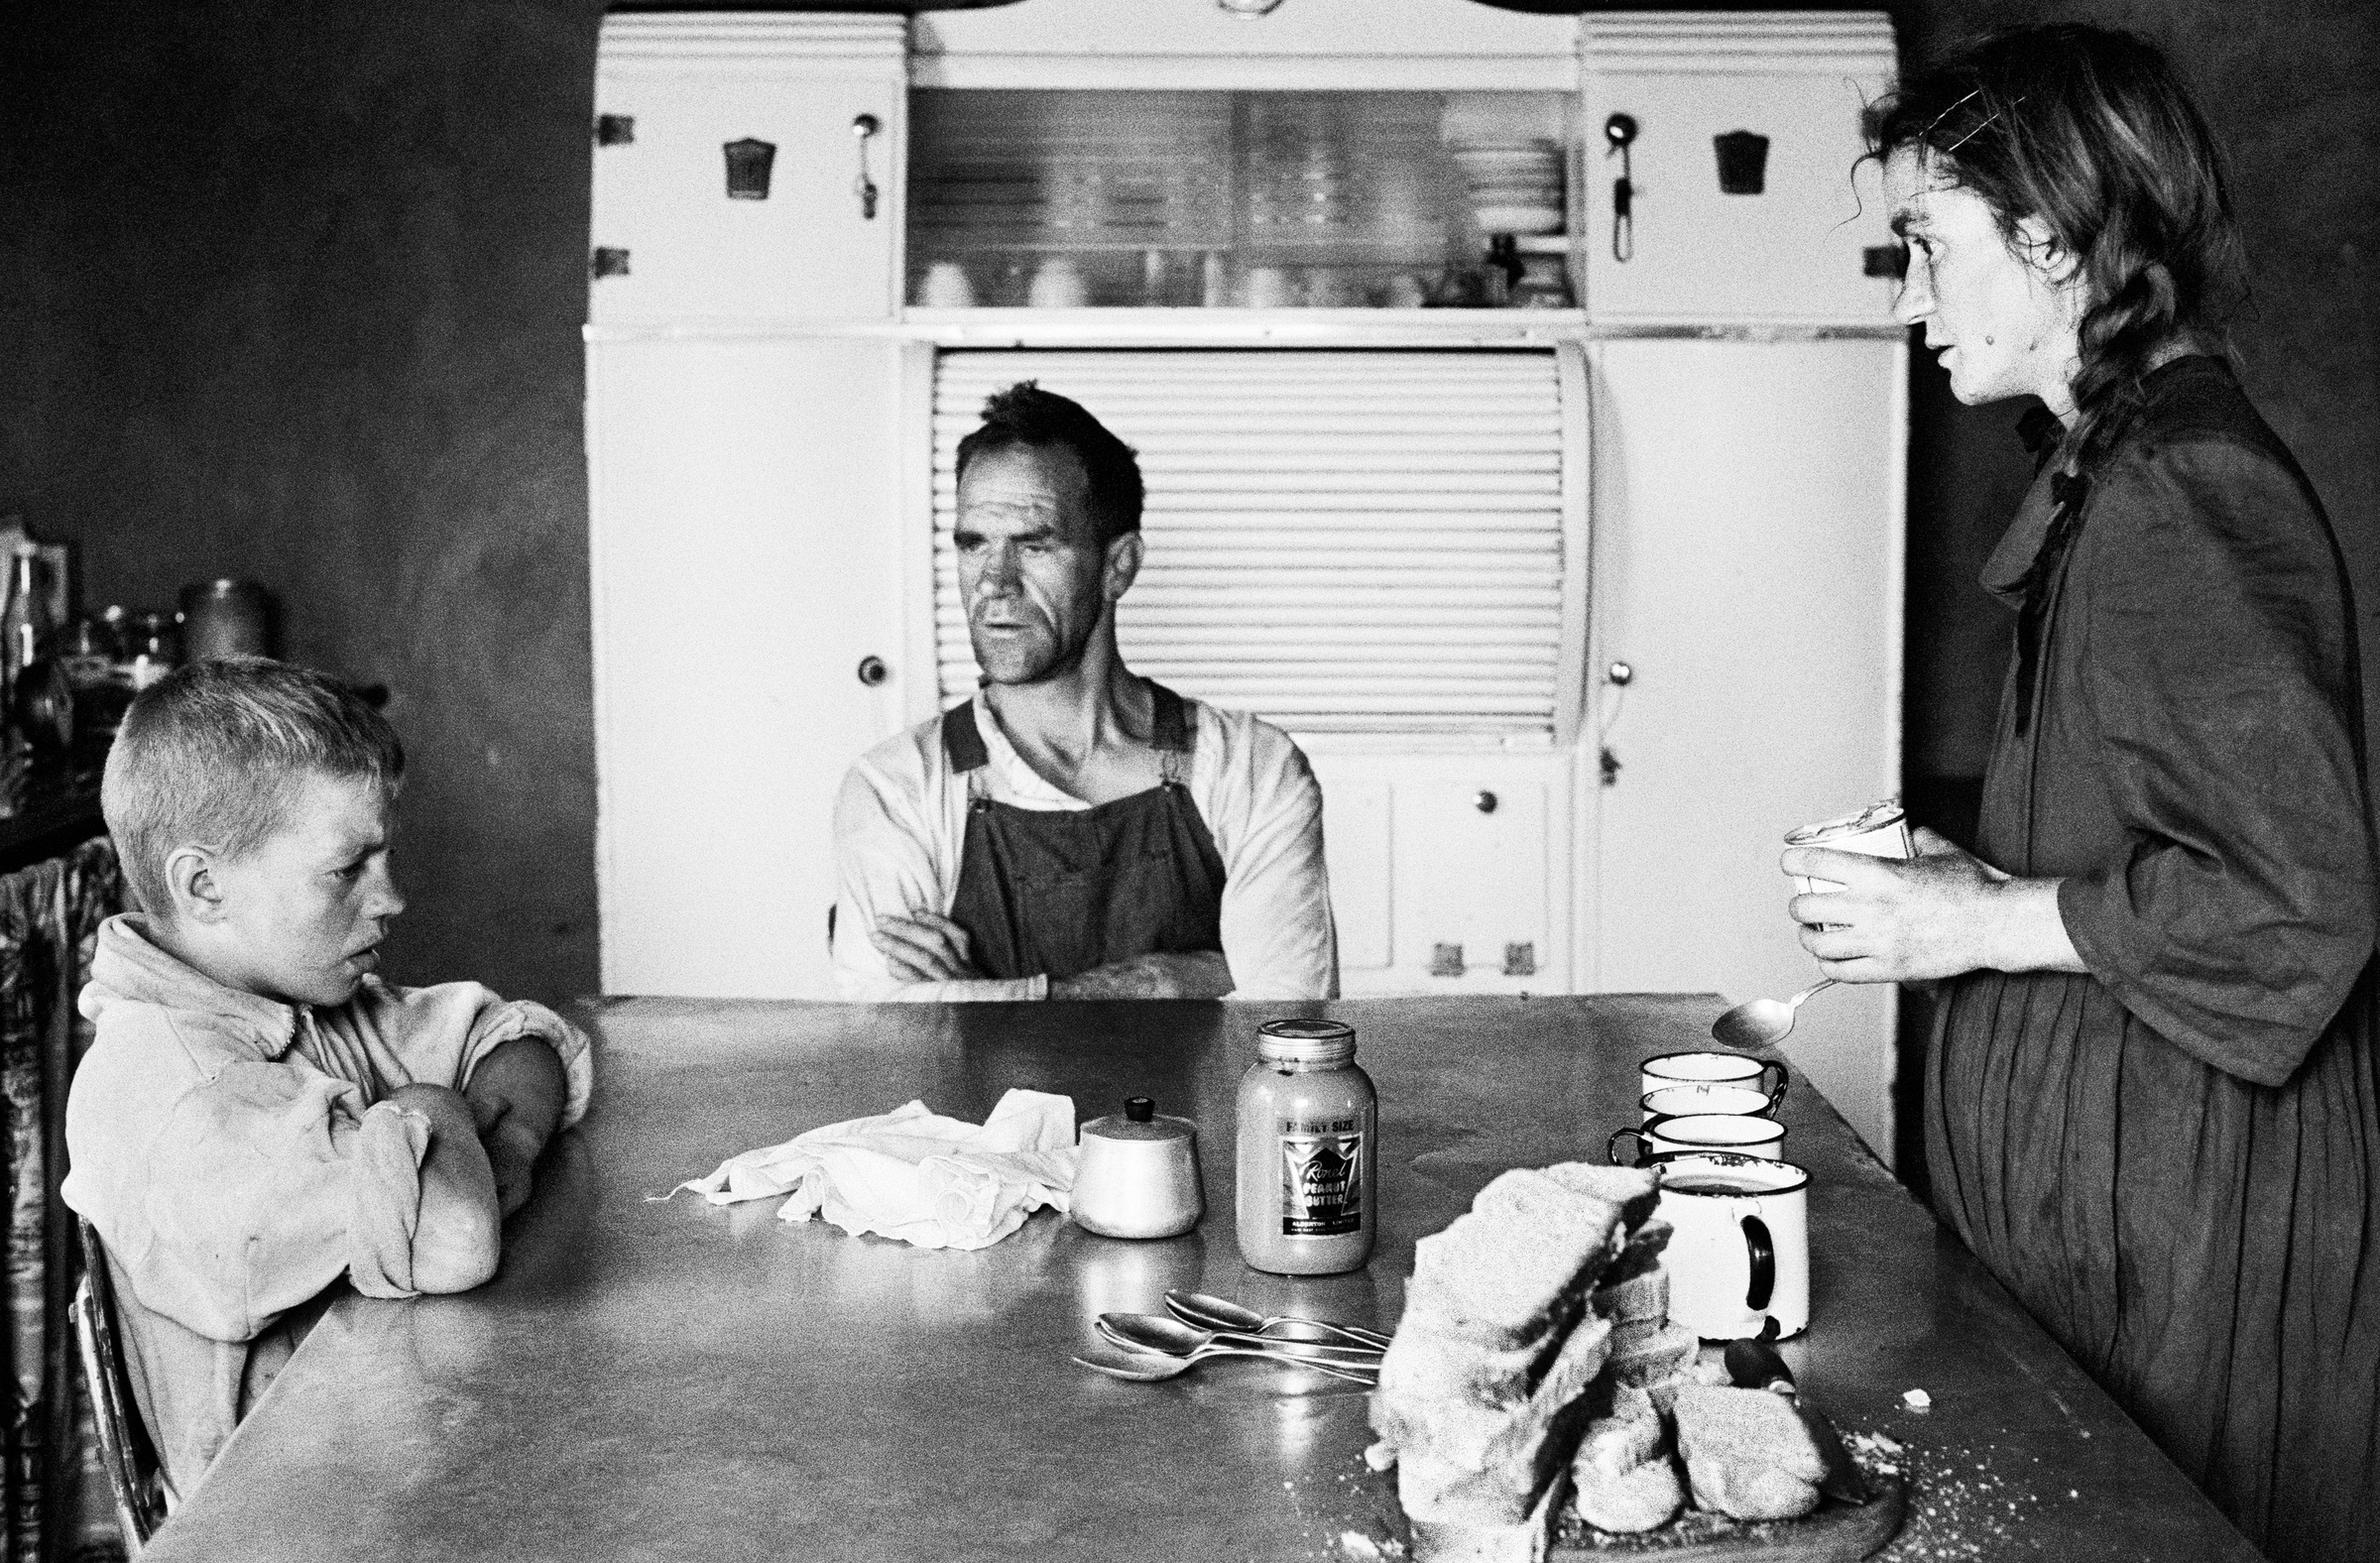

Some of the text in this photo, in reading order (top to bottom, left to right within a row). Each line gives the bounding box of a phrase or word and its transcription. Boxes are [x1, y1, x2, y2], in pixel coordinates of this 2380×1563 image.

[1286, 1120, 1355, 1134] FMILY SIZE
[1302, 1180, 1347, 1195] PEANUT
[1305, 1194, 1344, 1208] BUTTER
